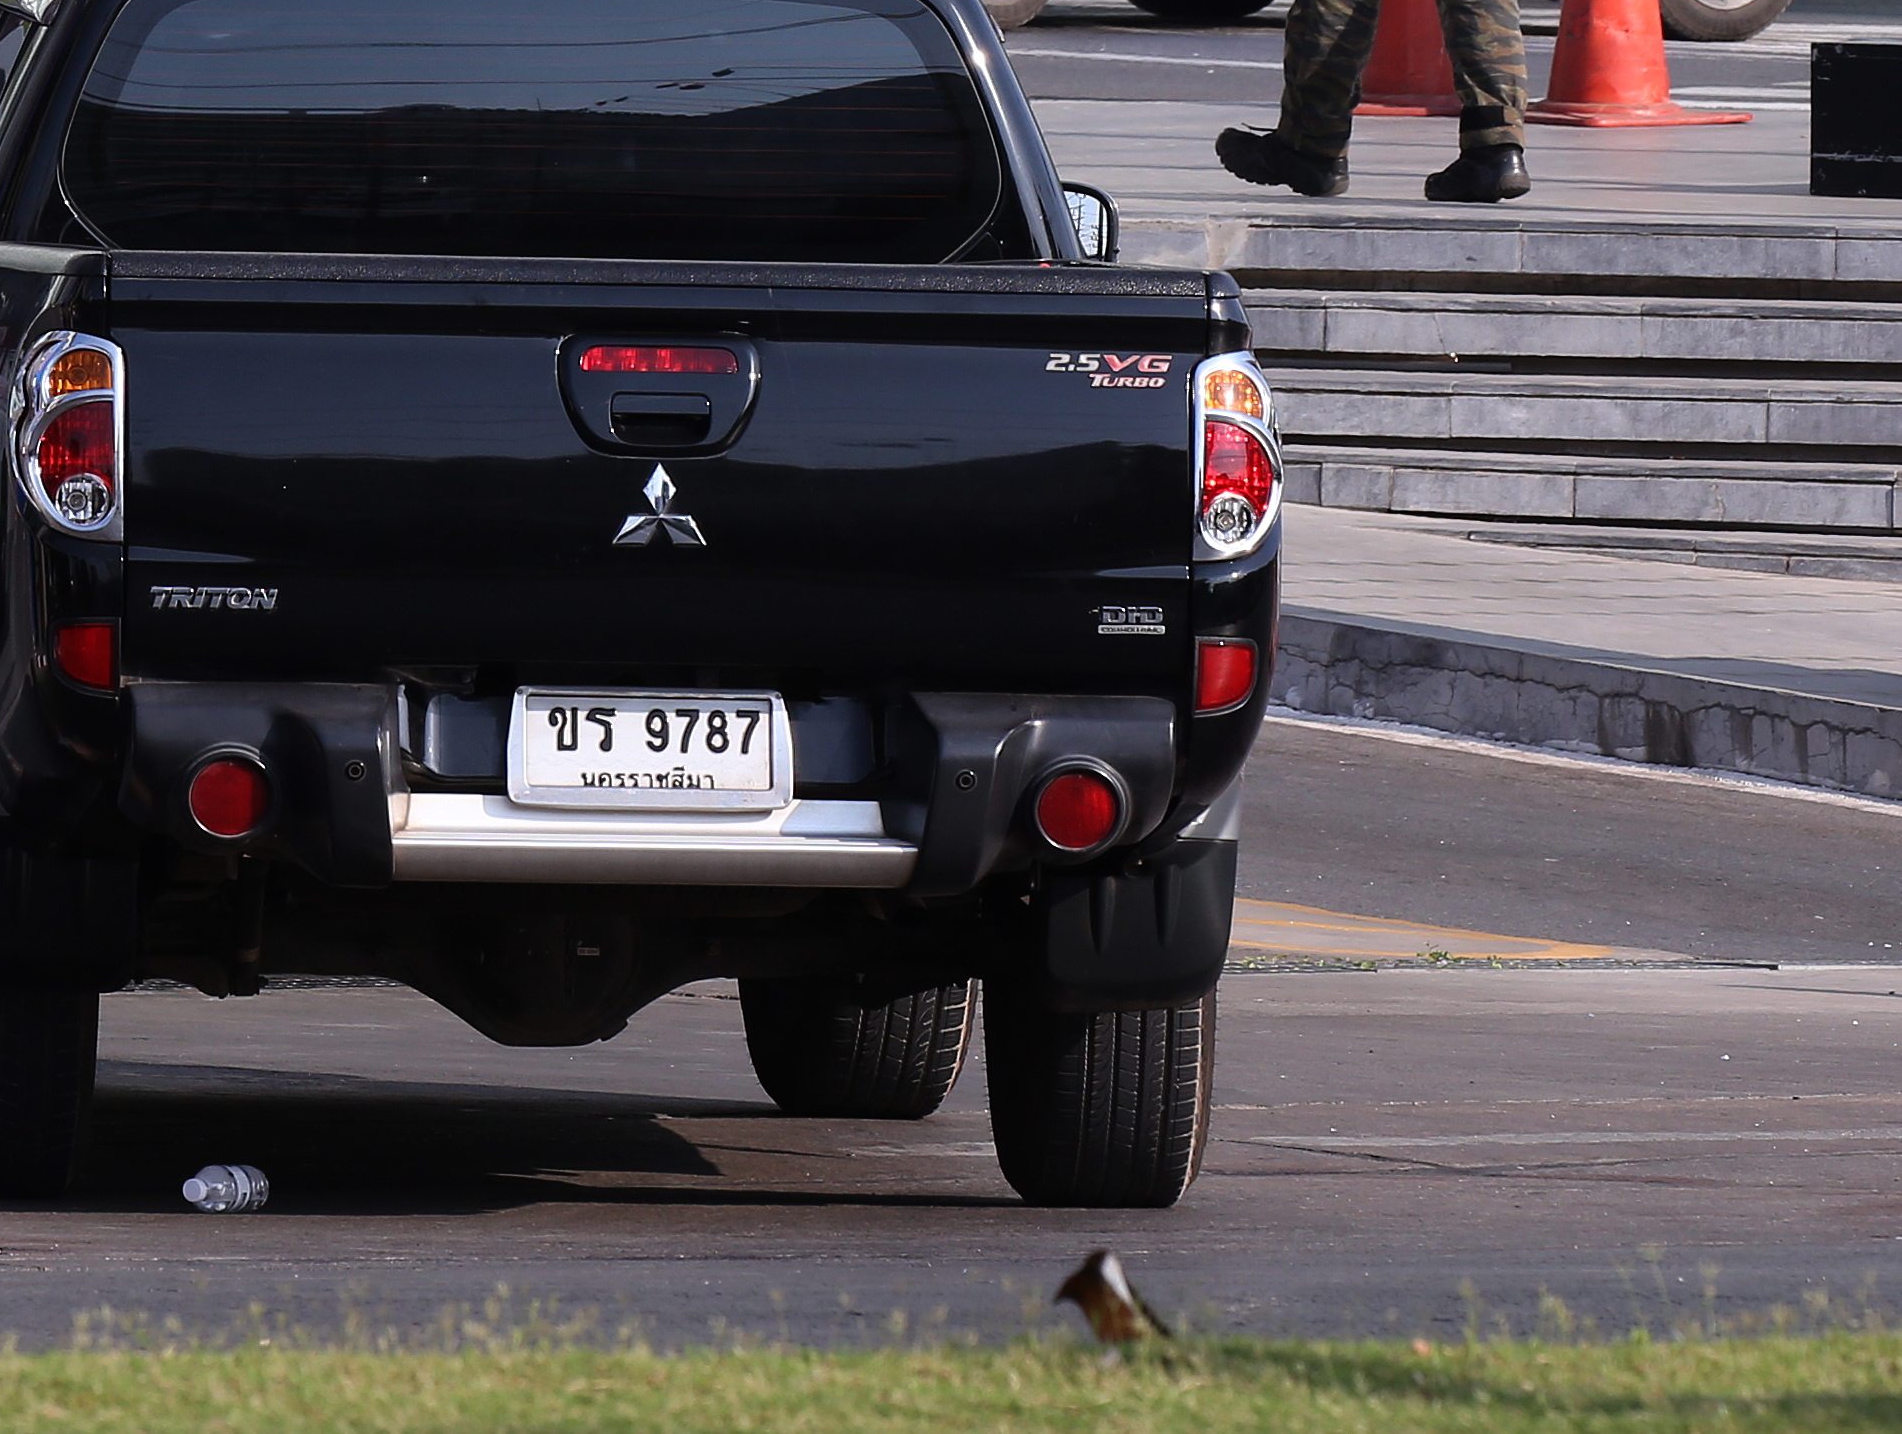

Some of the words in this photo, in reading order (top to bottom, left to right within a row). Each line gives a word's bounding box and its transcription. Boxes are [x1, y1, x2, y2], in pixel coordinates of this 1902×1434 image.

[150, 586, 279, 610] TRITON
[548, 707, 616, 752] ขร
[645, 708, 761, 754] 9787
[581, 766, 715, 790] นครราชสีมา
